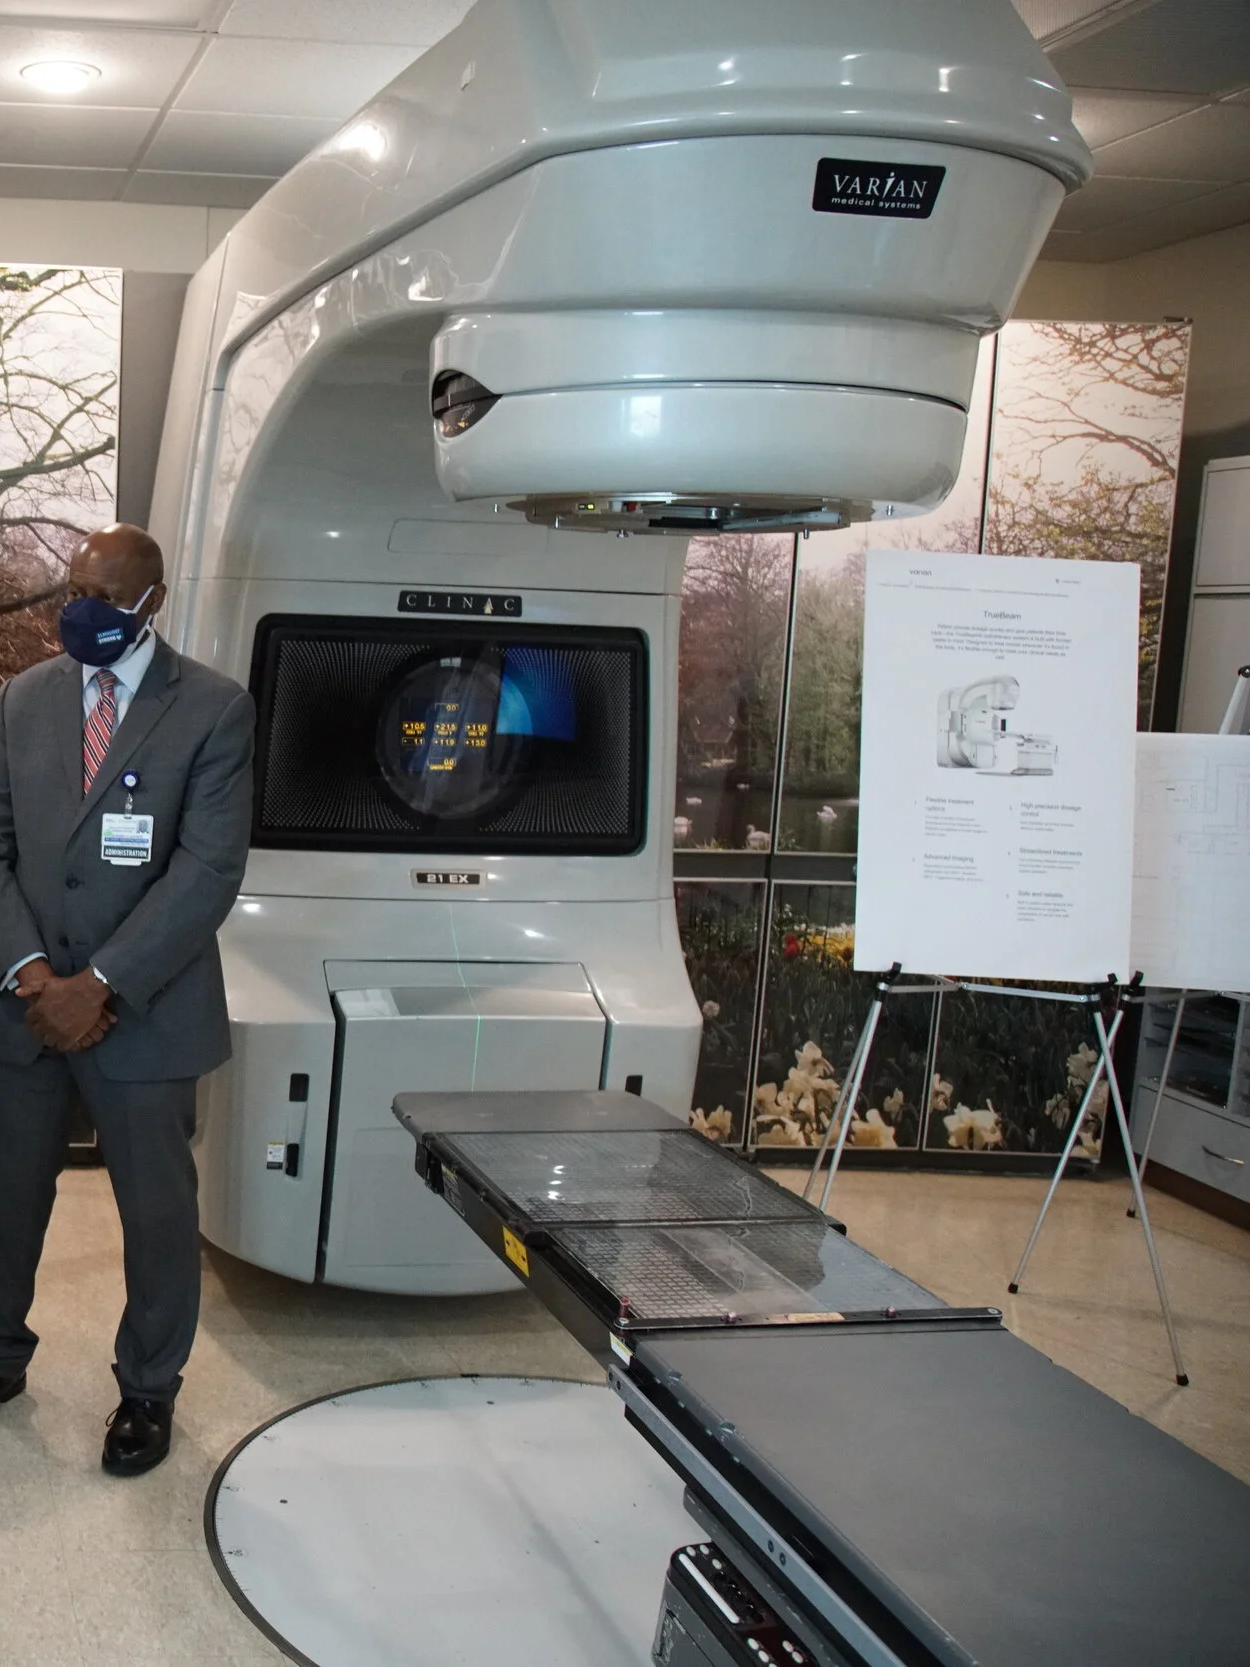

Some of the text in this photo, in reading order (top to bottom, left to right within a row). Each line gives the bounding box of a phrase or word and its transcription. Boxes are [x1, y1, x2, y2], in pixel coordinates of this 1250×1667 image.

[833, 171, 928, 199] VARIAN
[831, 197, 922, 210] medical systems
[406, 593, 515, 615] CLINAC
[983, 610, 1022, 621] TrueBeam
[105, 848, 148, 858] ADMINISTRATION
[427, 873, 469, 884] 21 EX
